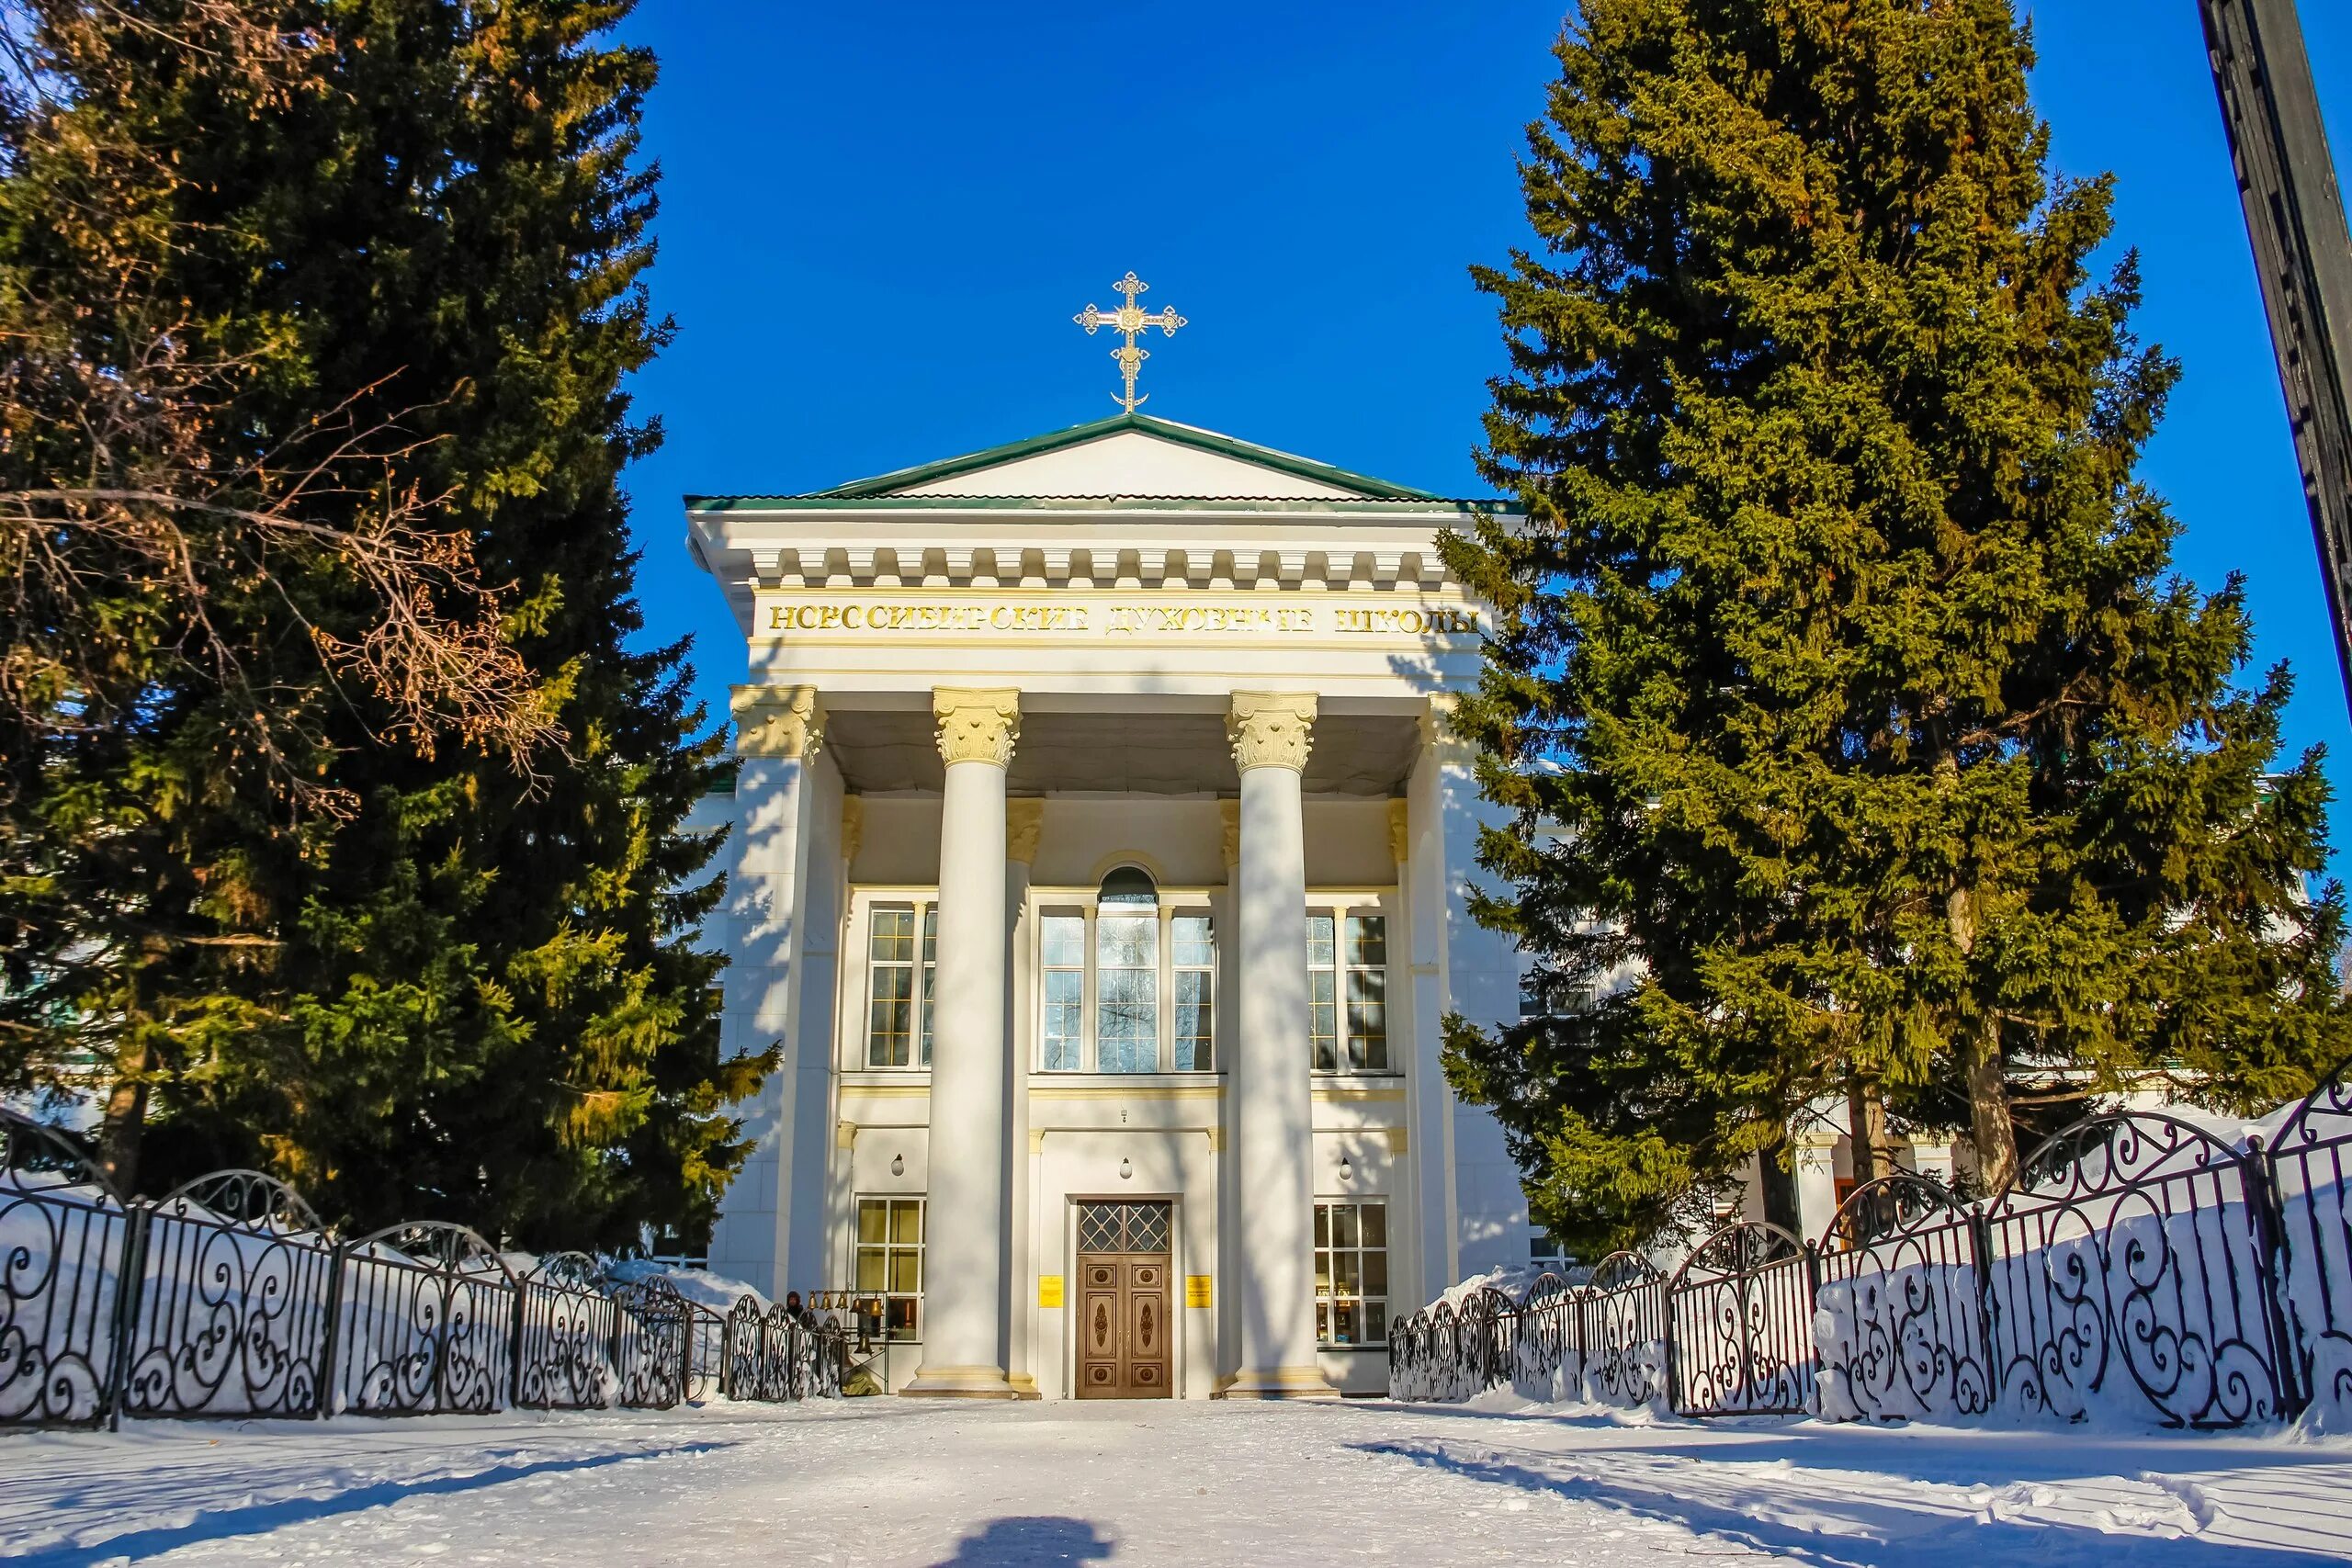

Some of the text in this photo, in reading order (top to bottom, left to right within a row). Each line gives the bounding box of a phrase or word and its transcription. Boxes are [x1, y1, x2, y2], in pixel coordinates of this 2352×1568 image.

[769, 605, 1480, 635] НОВОСИБИРСКИЕ ДУХОВНЫЕ ШКОЛЫ
